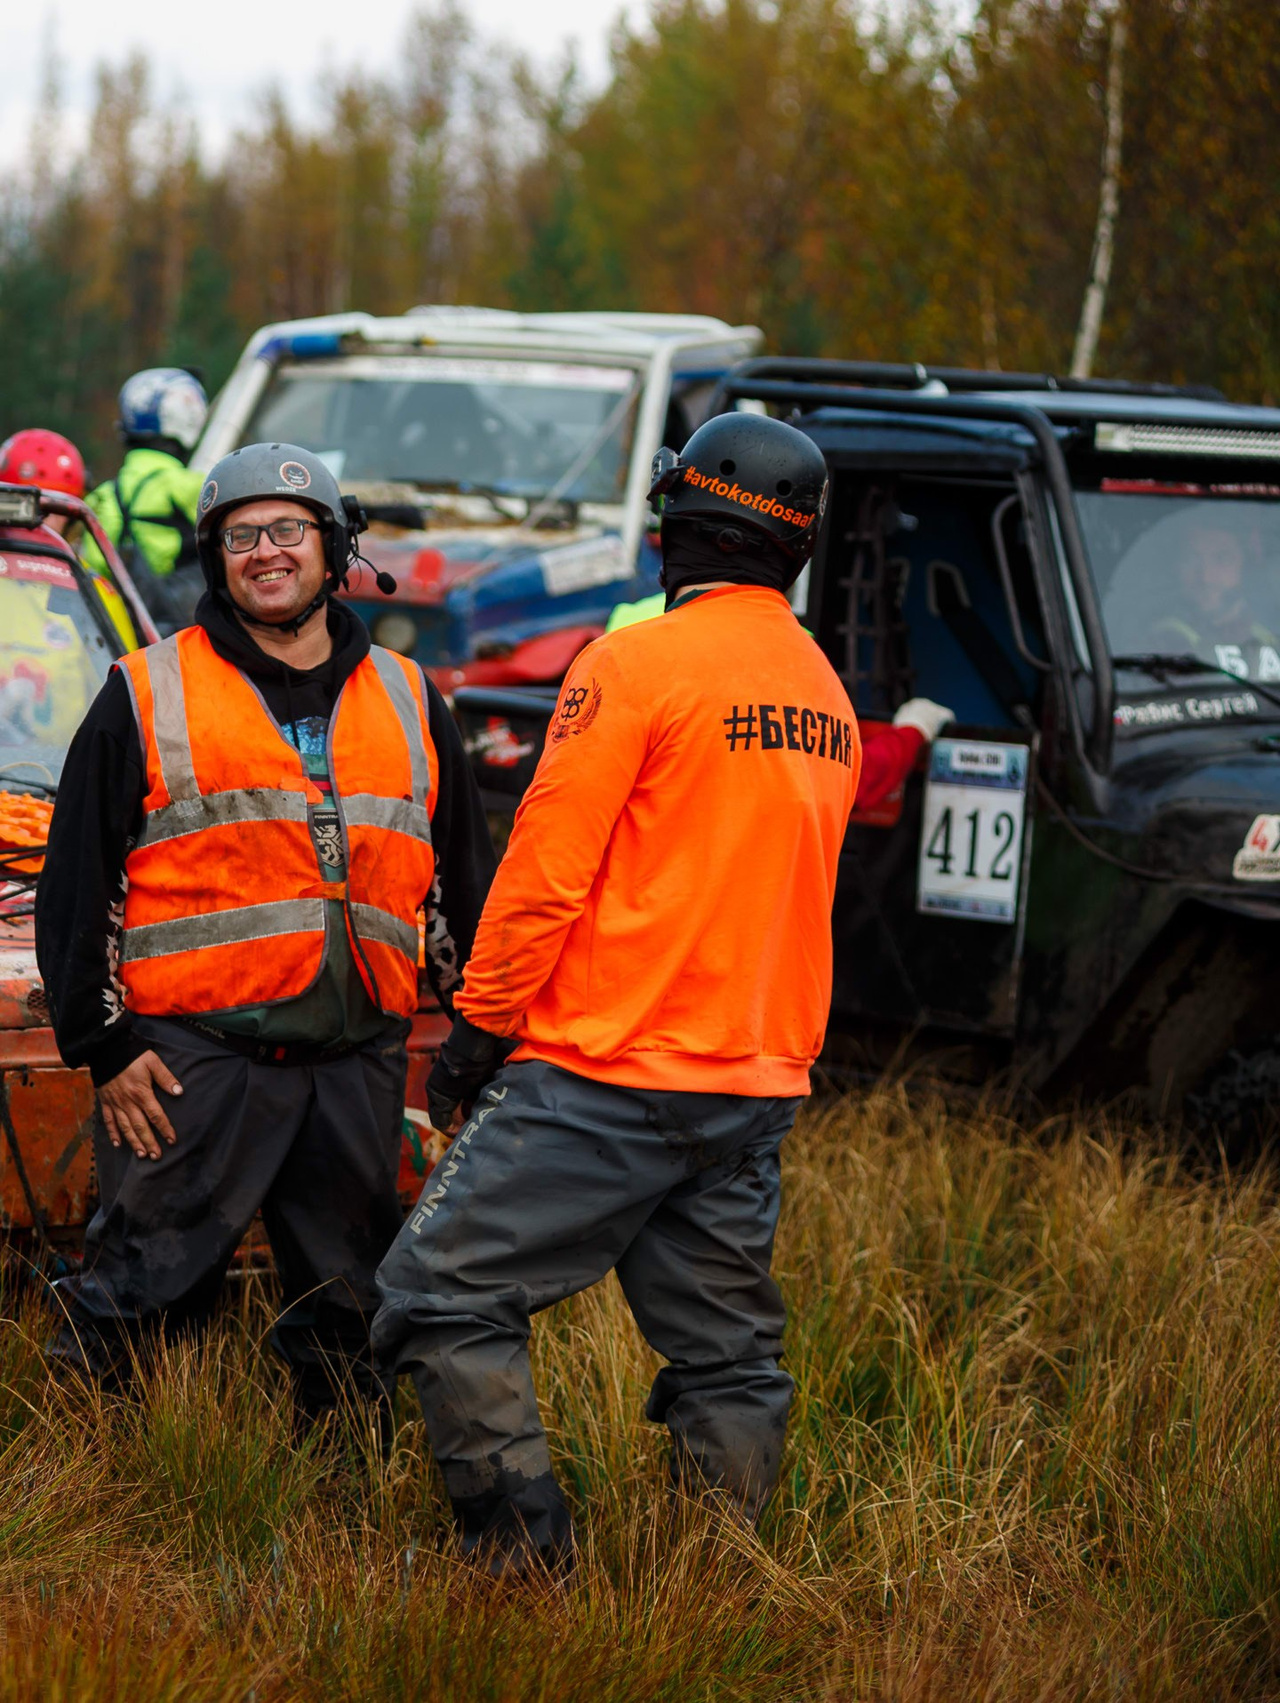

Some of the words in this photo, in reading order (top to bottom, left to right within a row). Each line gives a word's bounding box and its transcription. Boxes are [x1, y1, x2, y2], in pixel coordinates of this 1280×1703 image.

[723, 704, 852, 769] #БЕСТИЯ
[1185, 692, 1259, 720] Сергей
[926, 805, 1015, 881] 412
[409, 1086, 509, 1235] FINNTRAIL
